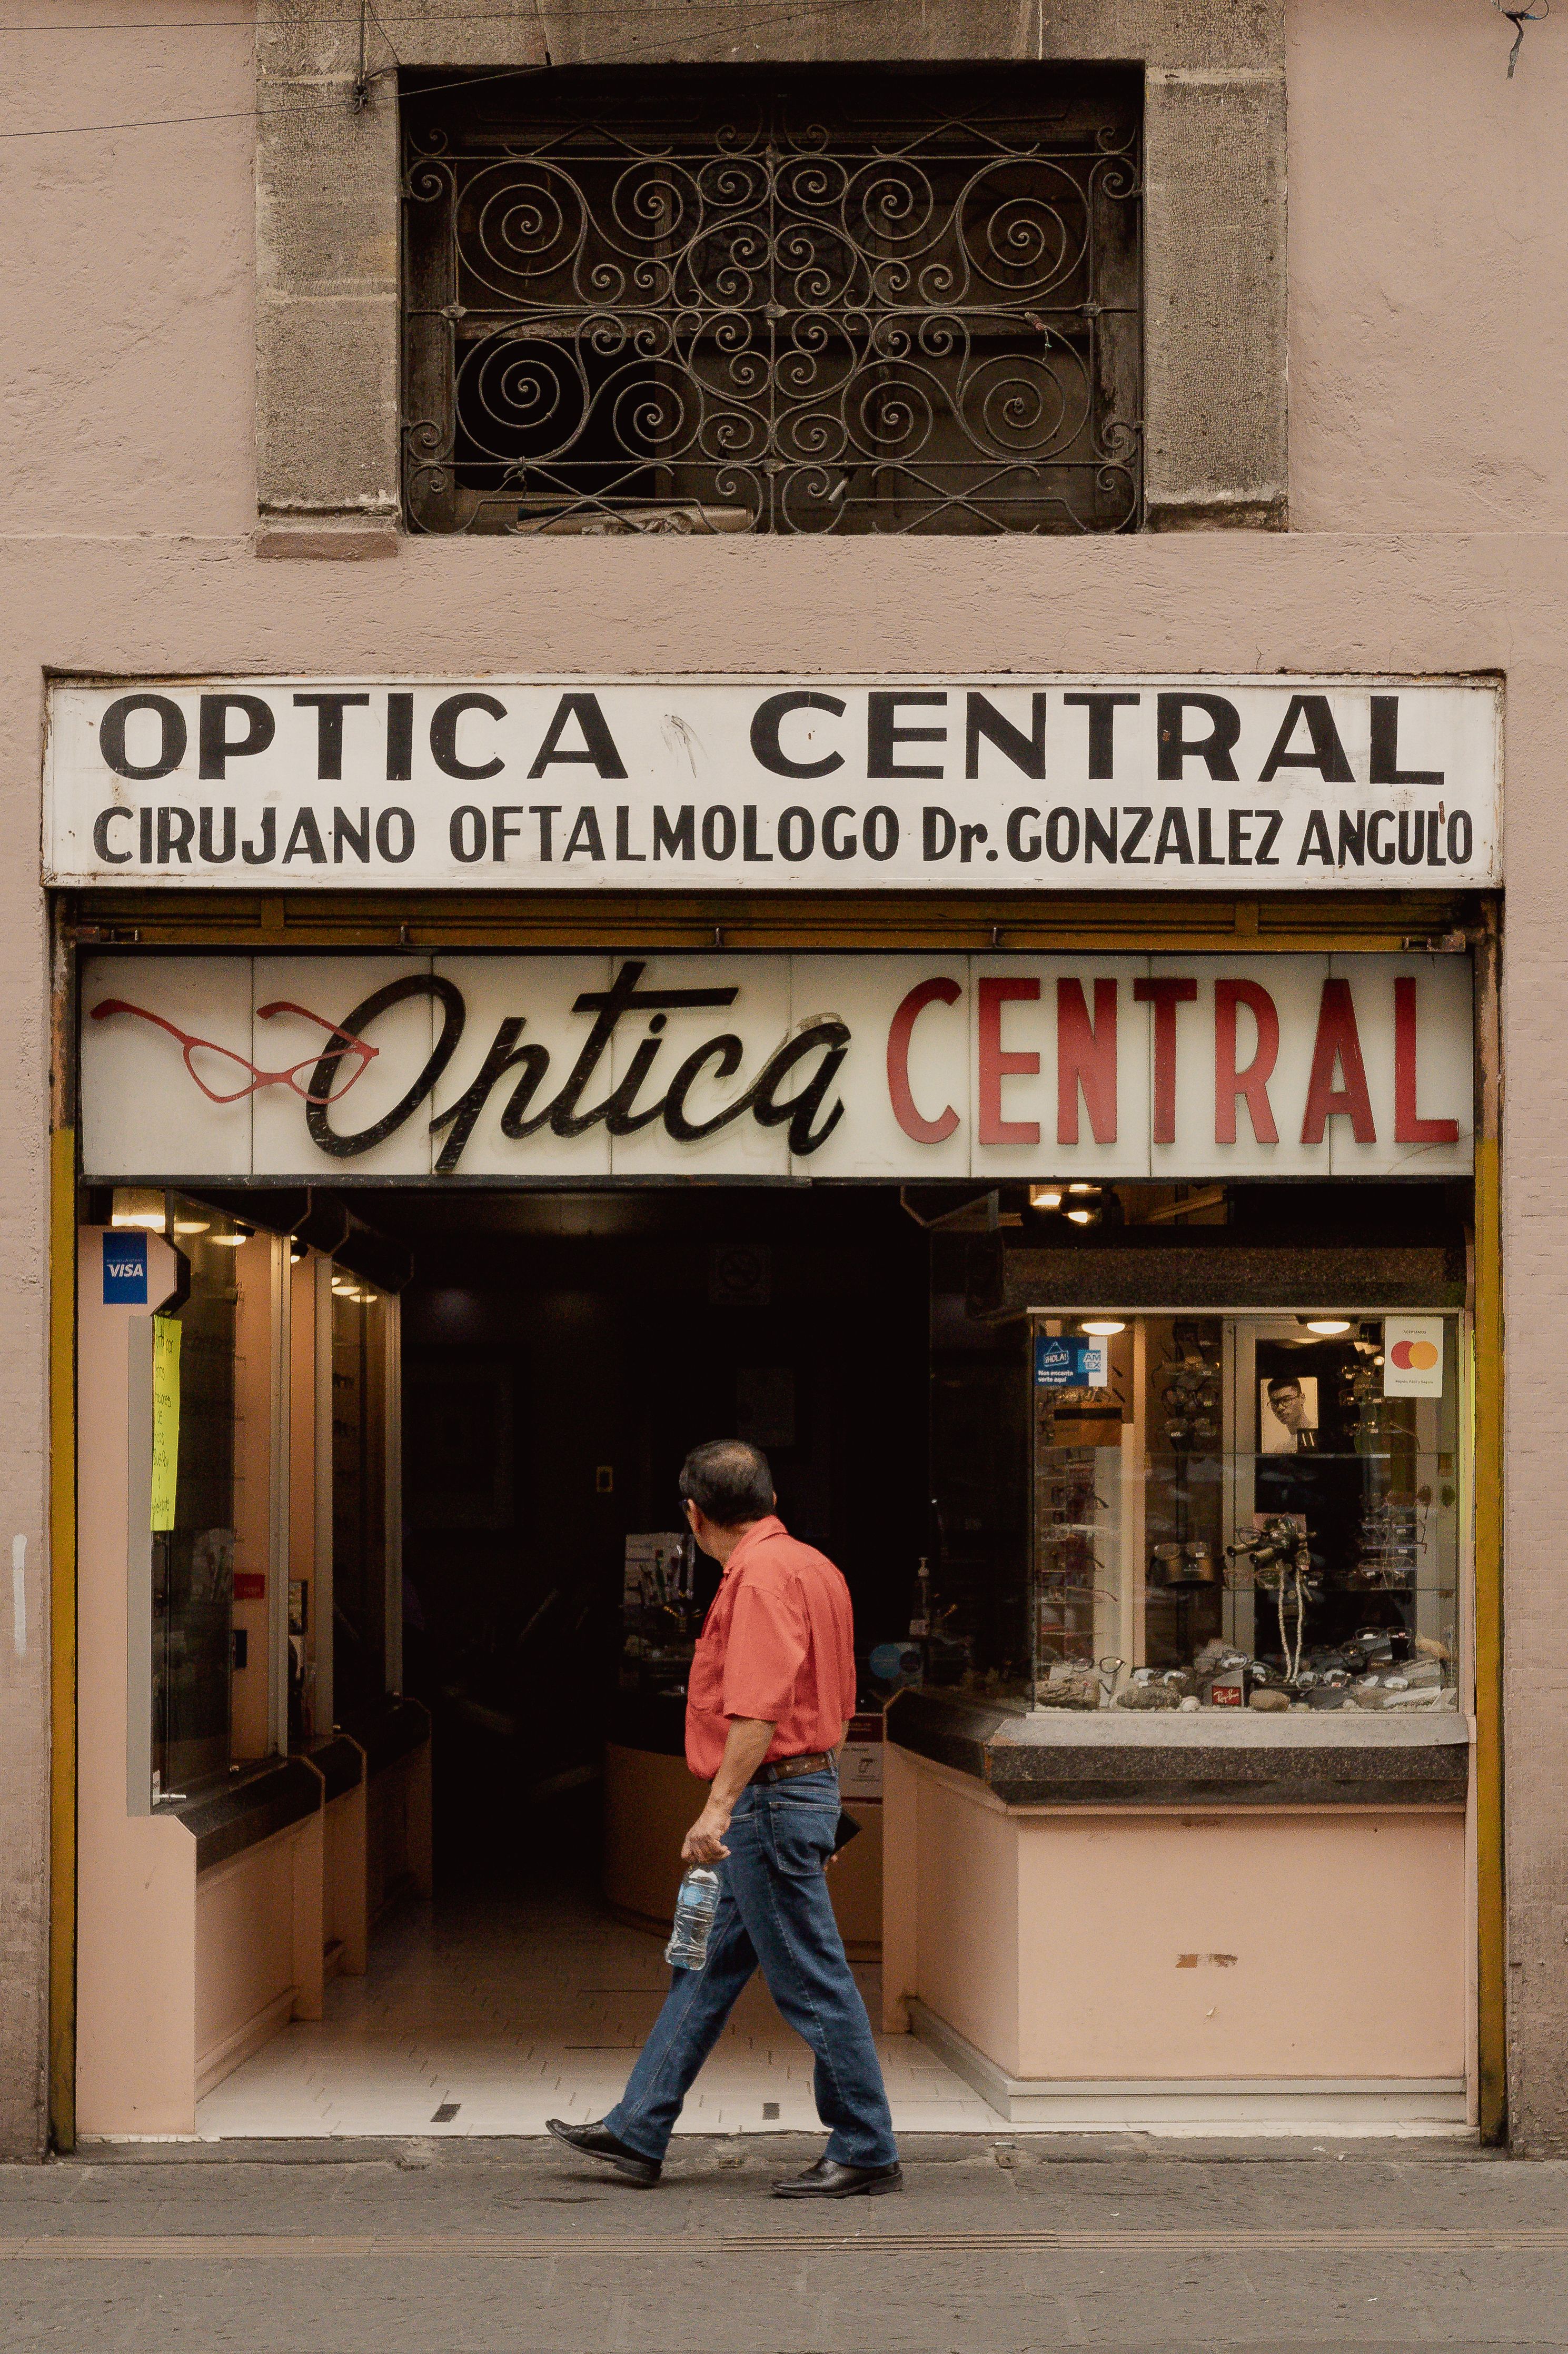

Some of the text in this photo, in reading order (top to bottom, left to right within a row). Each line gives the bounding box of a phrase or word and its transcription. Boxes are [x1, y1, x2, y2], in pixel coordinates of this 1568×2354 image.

[99, 690, 1445, 785] OPTICA CENTRAL
[93, 805, 1473, 867] CIRUJANO OFTALMOLOGO Dr. GONZALEZ ANGULO
[305, 961, 1460, 1172] Optica CENTRAL
[106, 1263, 143, 1277] VISA
